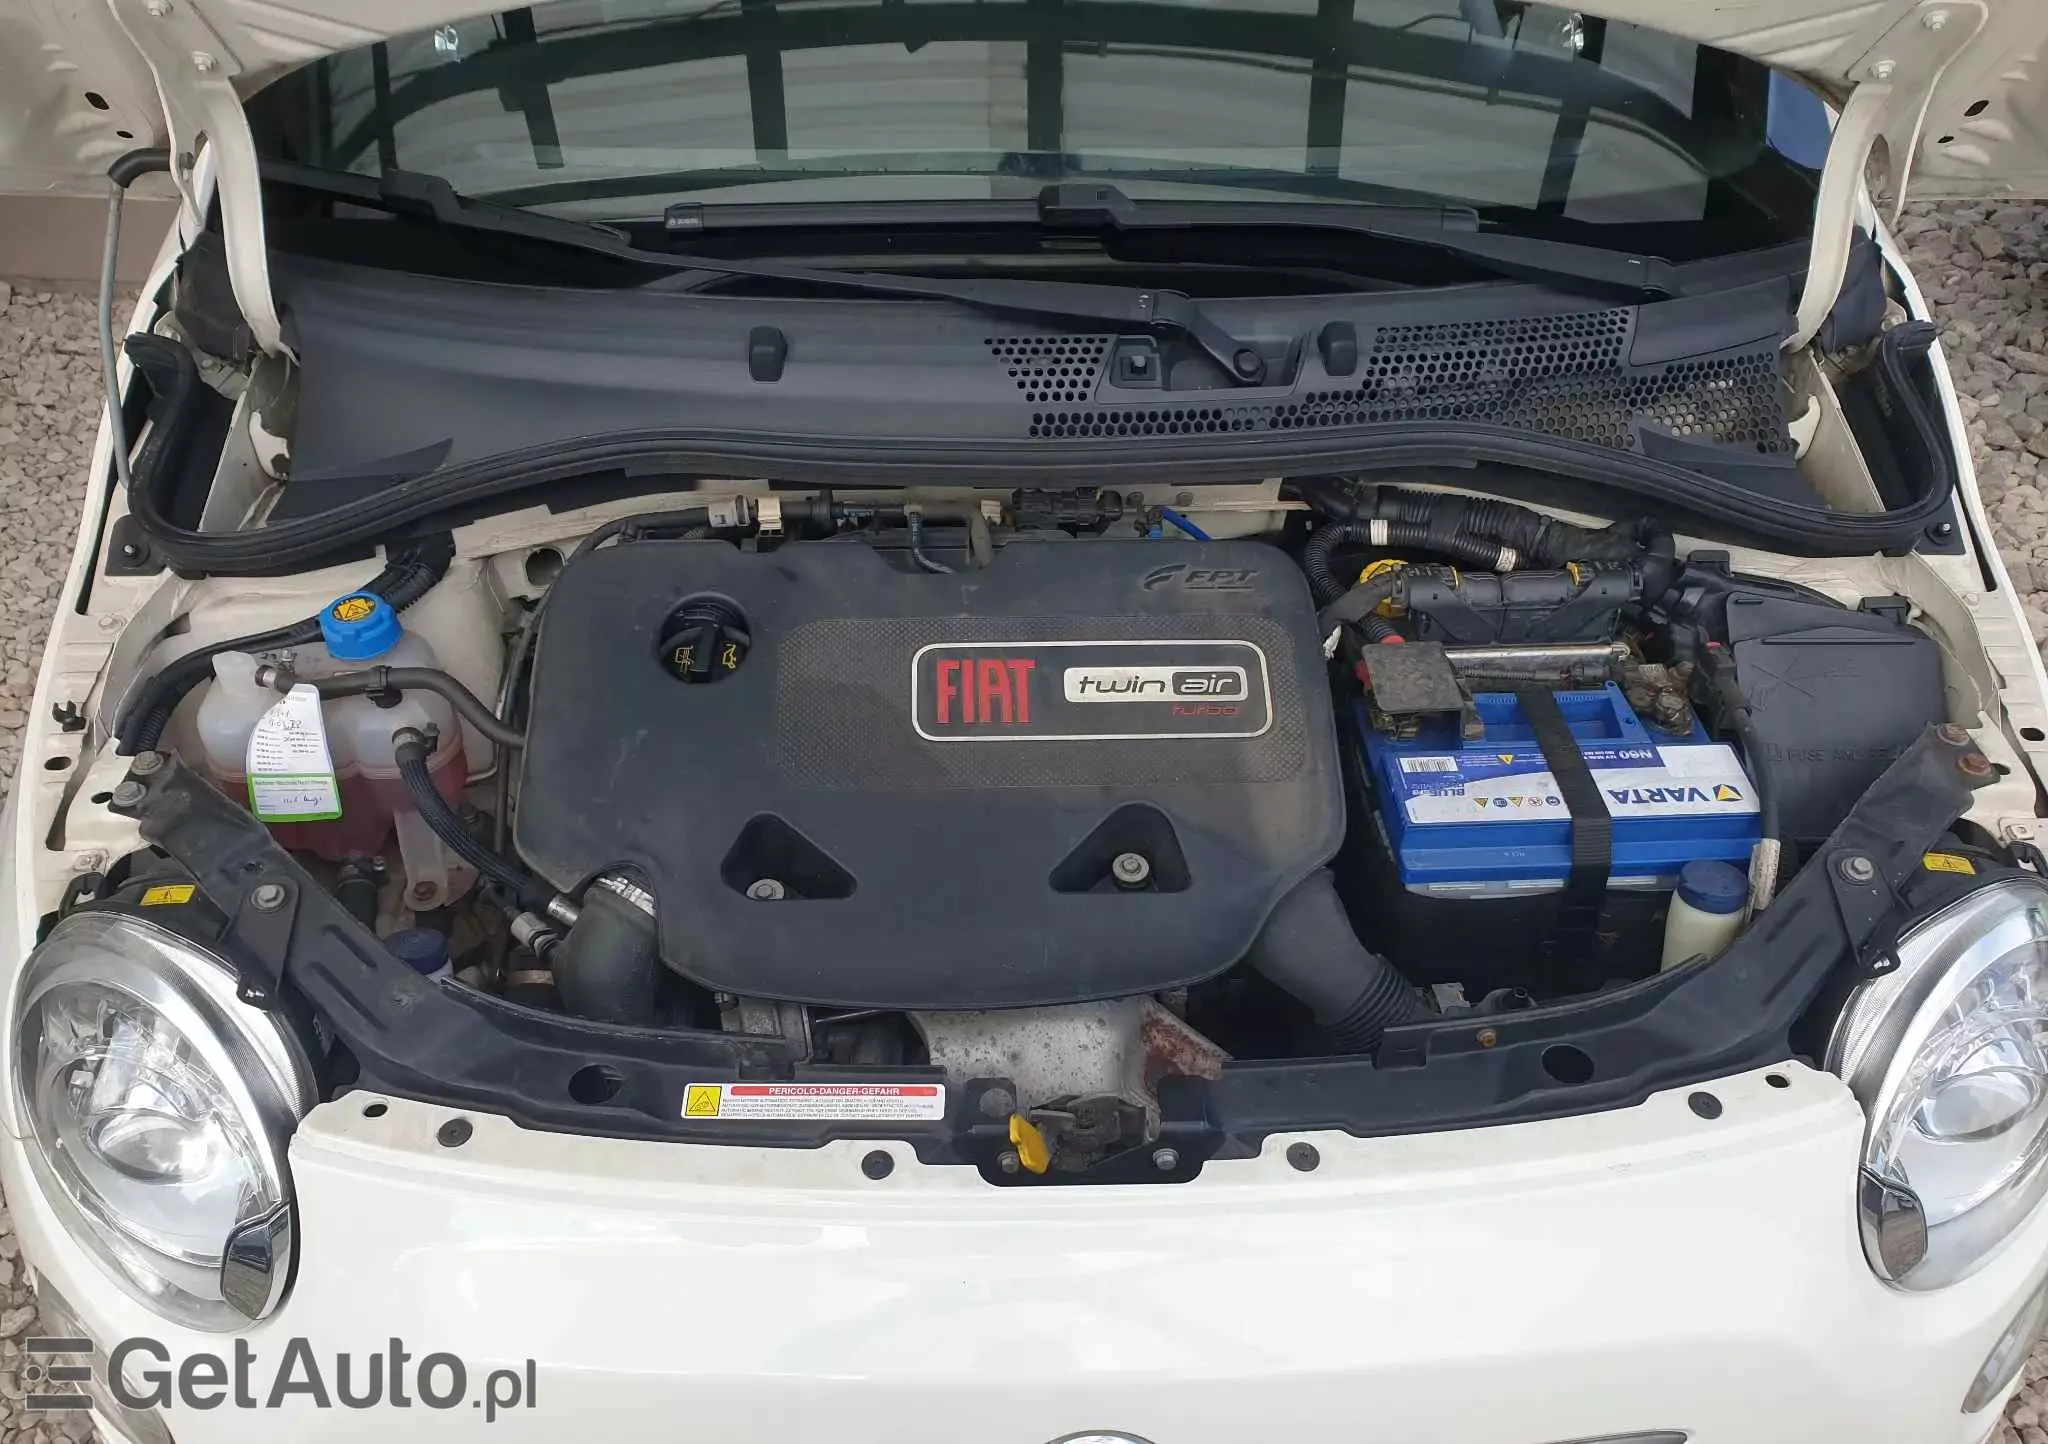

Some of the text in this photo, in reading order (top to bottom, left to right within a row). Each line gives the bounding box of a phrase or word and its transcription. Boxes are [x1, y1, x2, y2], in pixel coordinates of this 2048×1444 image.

[1183, 568, 1260, 586] FPT
[936, 658, 1037, 725] FIAT
[1079, 674, 1233, 694] twin air
[1171, 703, 1240, 717] turbo
[1619, 749, 1653, 760] N60
[1607, 787, 1711, 805] VARTA
[768, 1087, 900, 1096] PERICOLO-DANGER-GEFAHR
